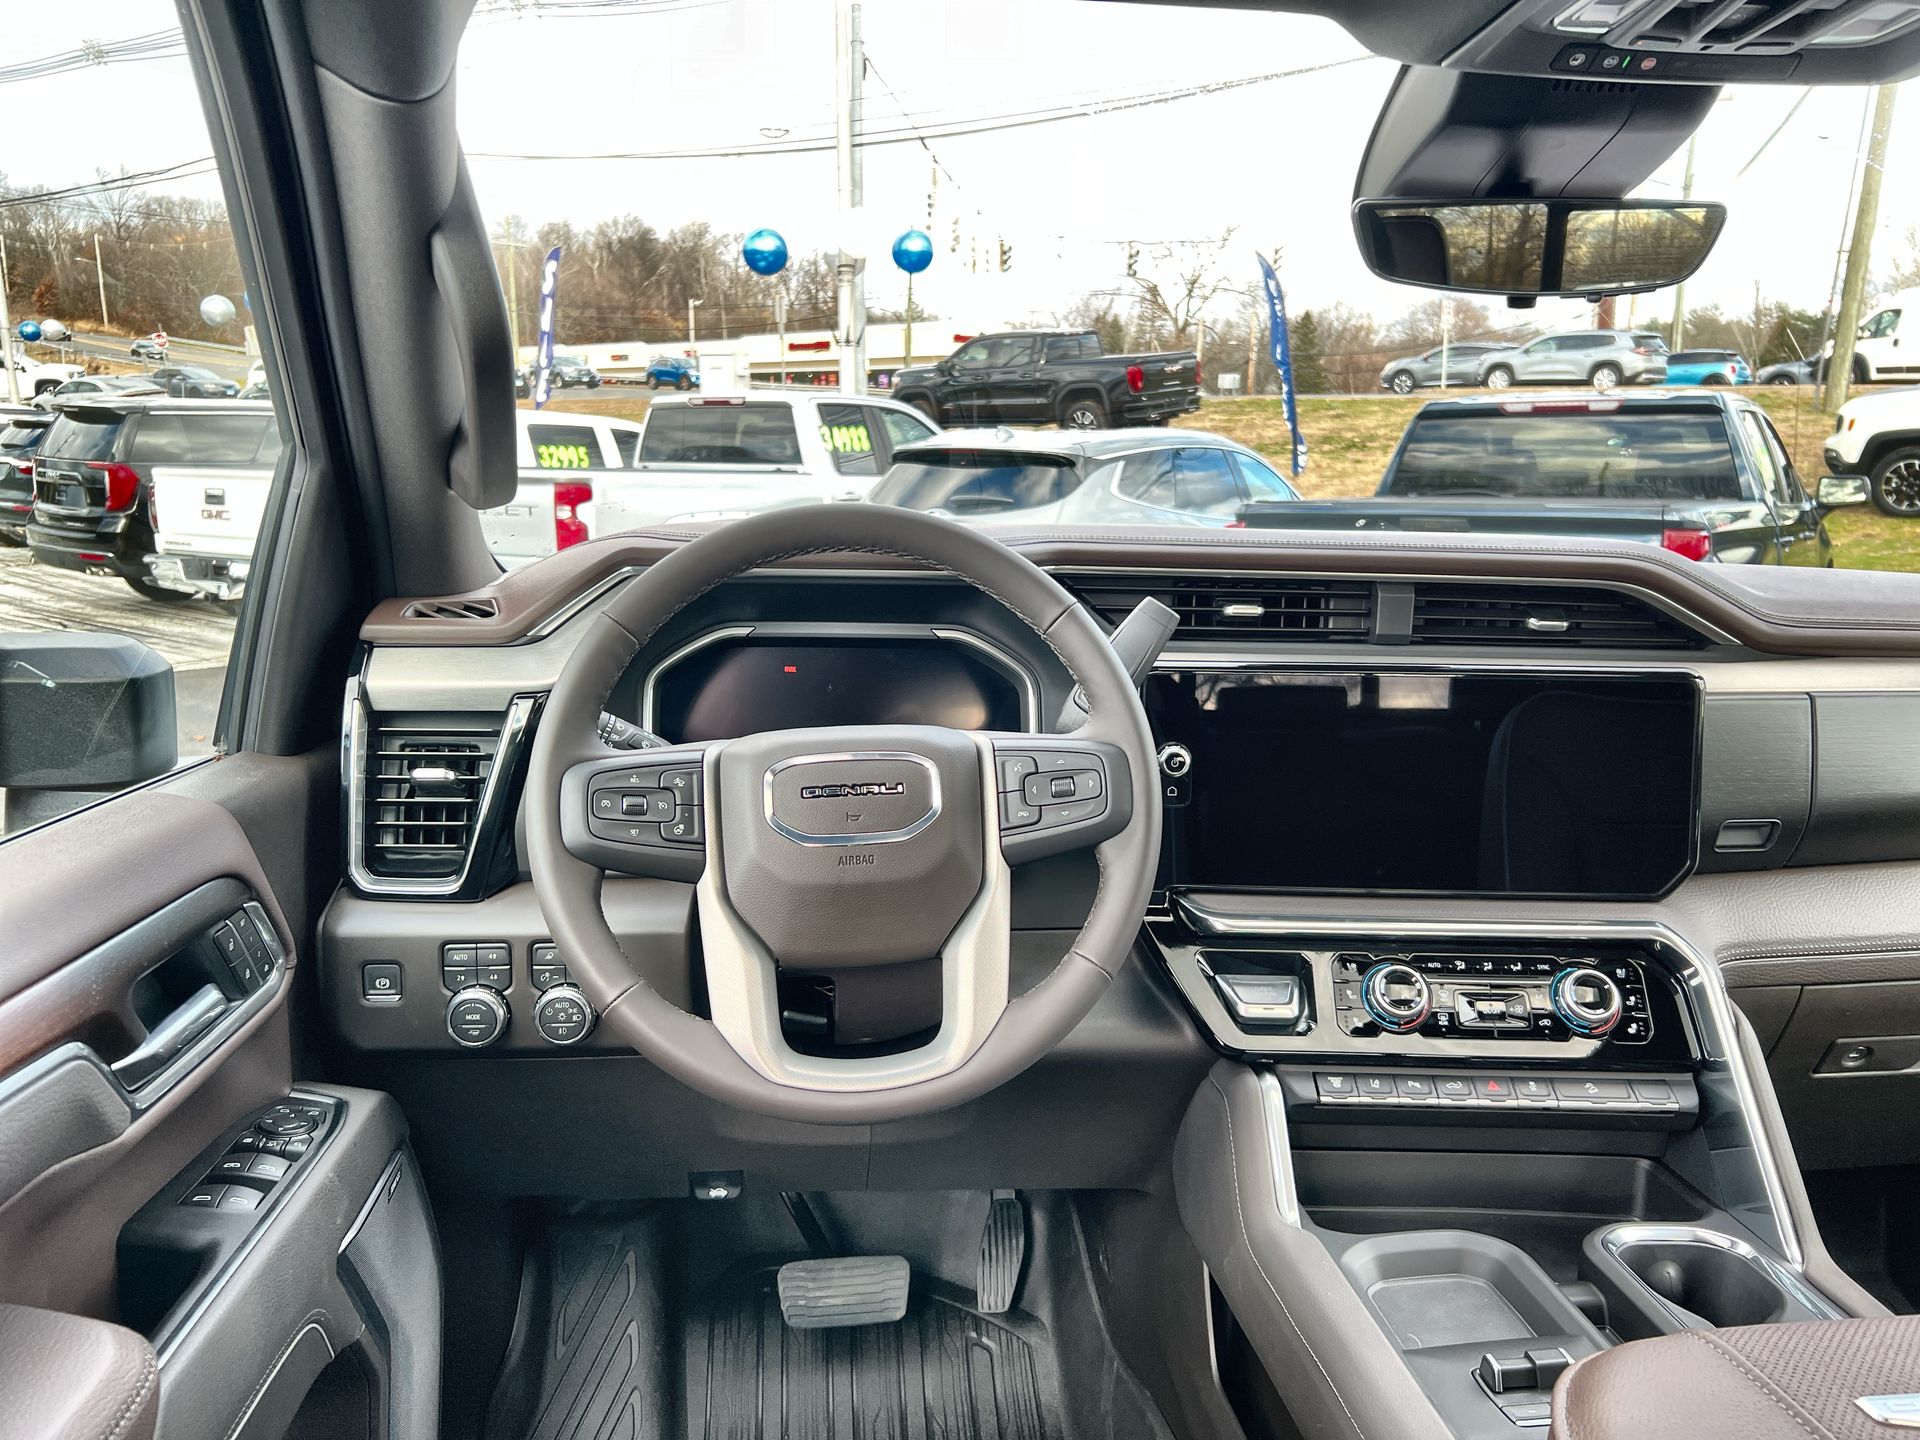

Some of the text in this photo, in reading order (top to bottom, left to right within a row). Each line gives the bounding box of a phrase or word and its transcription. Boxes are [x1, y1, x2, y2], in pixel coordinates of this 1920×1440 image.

[538, 444, 590, 468] 32995
[201, 509, 232, 521] GMC
[801, 782, 905, 799] DENALI
[837, 854, 875, 867] AIRBAG
[465, 1013, 481, 1021] MODE
